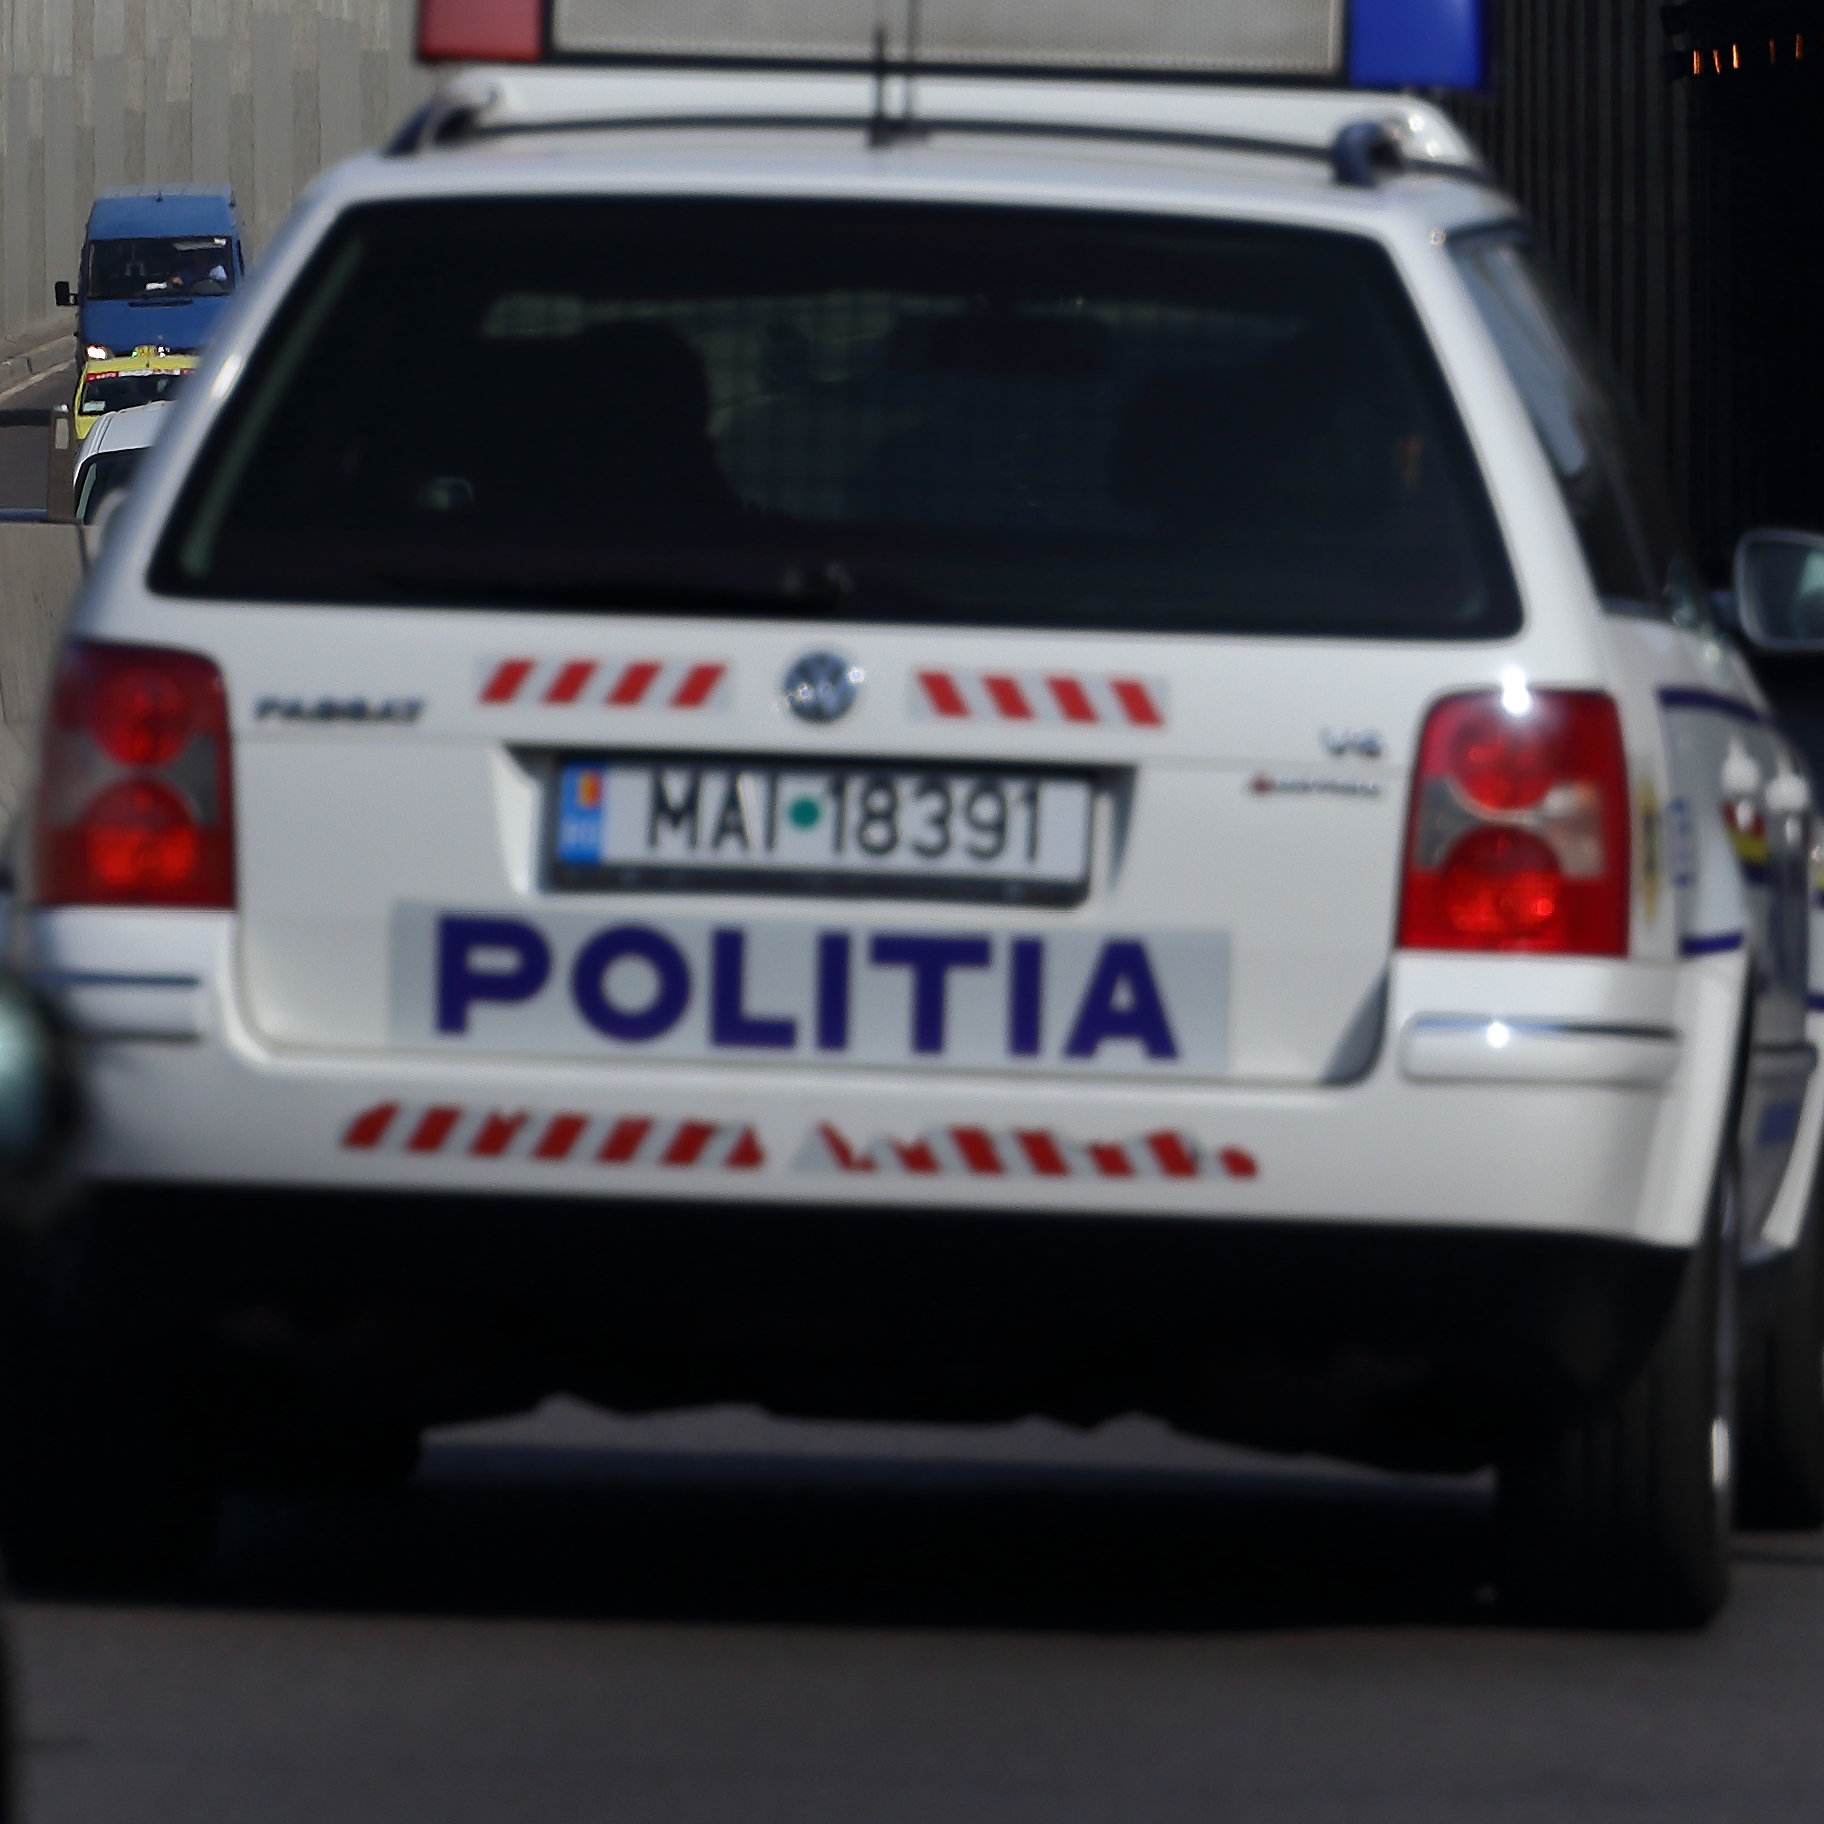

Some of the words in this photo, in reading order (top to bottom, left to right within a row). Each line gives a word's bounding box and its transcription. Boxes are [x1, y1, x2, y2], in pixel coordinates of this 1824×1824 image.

[644, 768, 777, 854] MAI
[828, 772, 1042, 866] 18391
[434, 913, 1183, 1062] POLITIA
